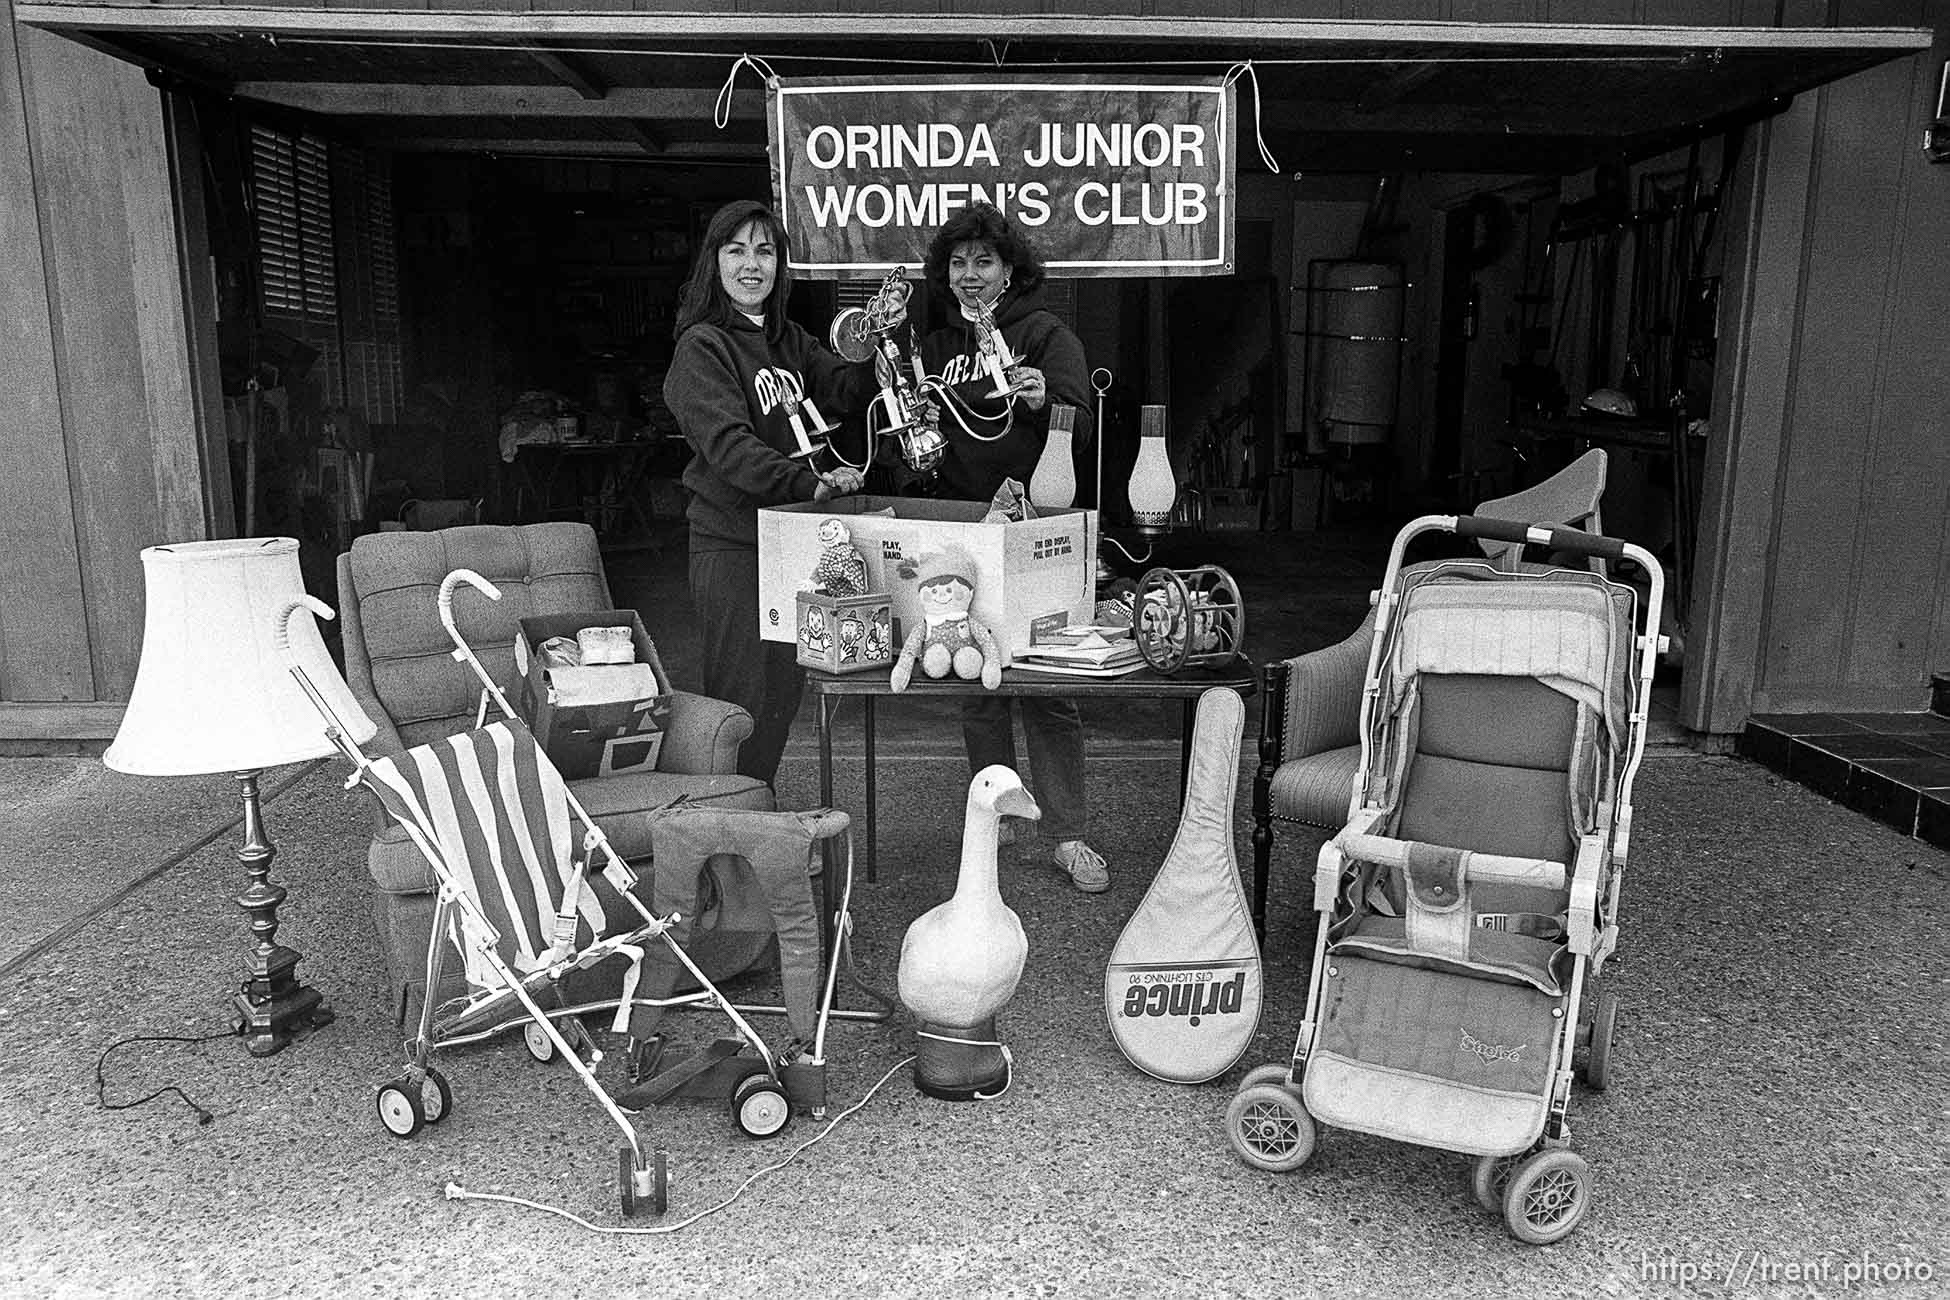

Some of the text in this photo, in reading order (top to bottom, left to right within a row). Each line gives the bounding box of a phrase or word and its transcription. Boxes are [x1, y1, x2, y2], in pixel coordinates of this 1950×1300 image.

[806, 122, 1205, 169] ORINDA JUNIOR
[804, 182, 1208, 228] WOMEN'S CLUB
[1123, 972, 1246, 1027] prince
[1129, 974, 1142, 984] 90
[1144, 972, 1193, 984] LIGHTNING
